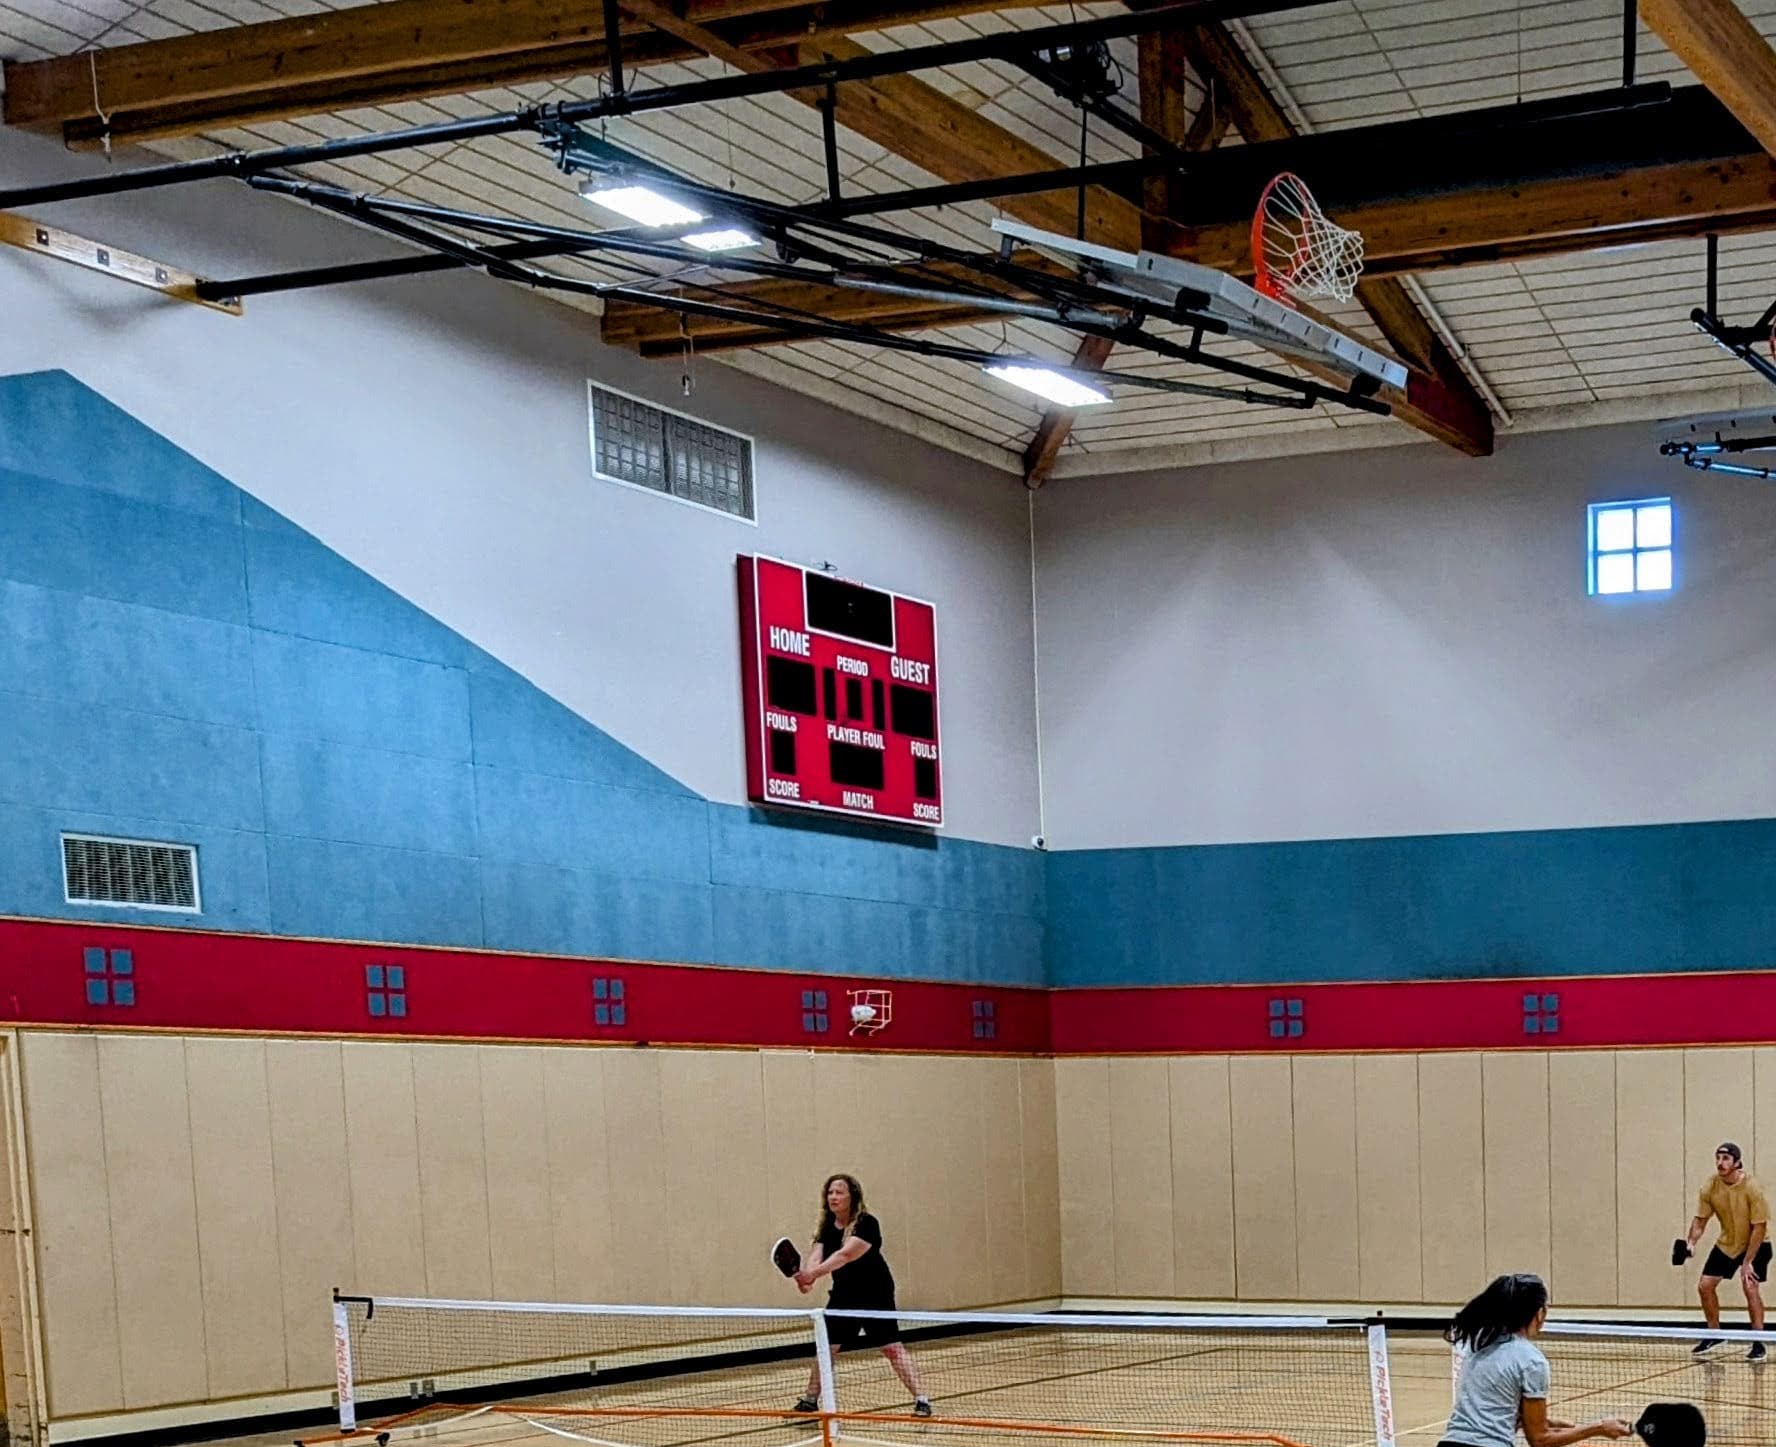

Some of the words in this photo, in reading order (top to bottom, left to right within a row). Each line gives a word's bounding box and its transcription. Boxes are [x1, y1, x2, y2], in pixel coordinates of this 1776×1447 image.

[769, 625, 810, 656] HOME
[837, 655, 868, 677] PERIOD
[890, 656, 930, 685] GUEST
[767, 711, 798, 732] FOULS
[827, 724, 861, 746] PLAYER
[863, 731, 885, 750] FOUL
[910, 741, 937, 759] FOULS
[769, 778, 800, 798] SCORE
[842, 791, 874, 809] MATCH
[913, 803, 940, 820] SCORE
